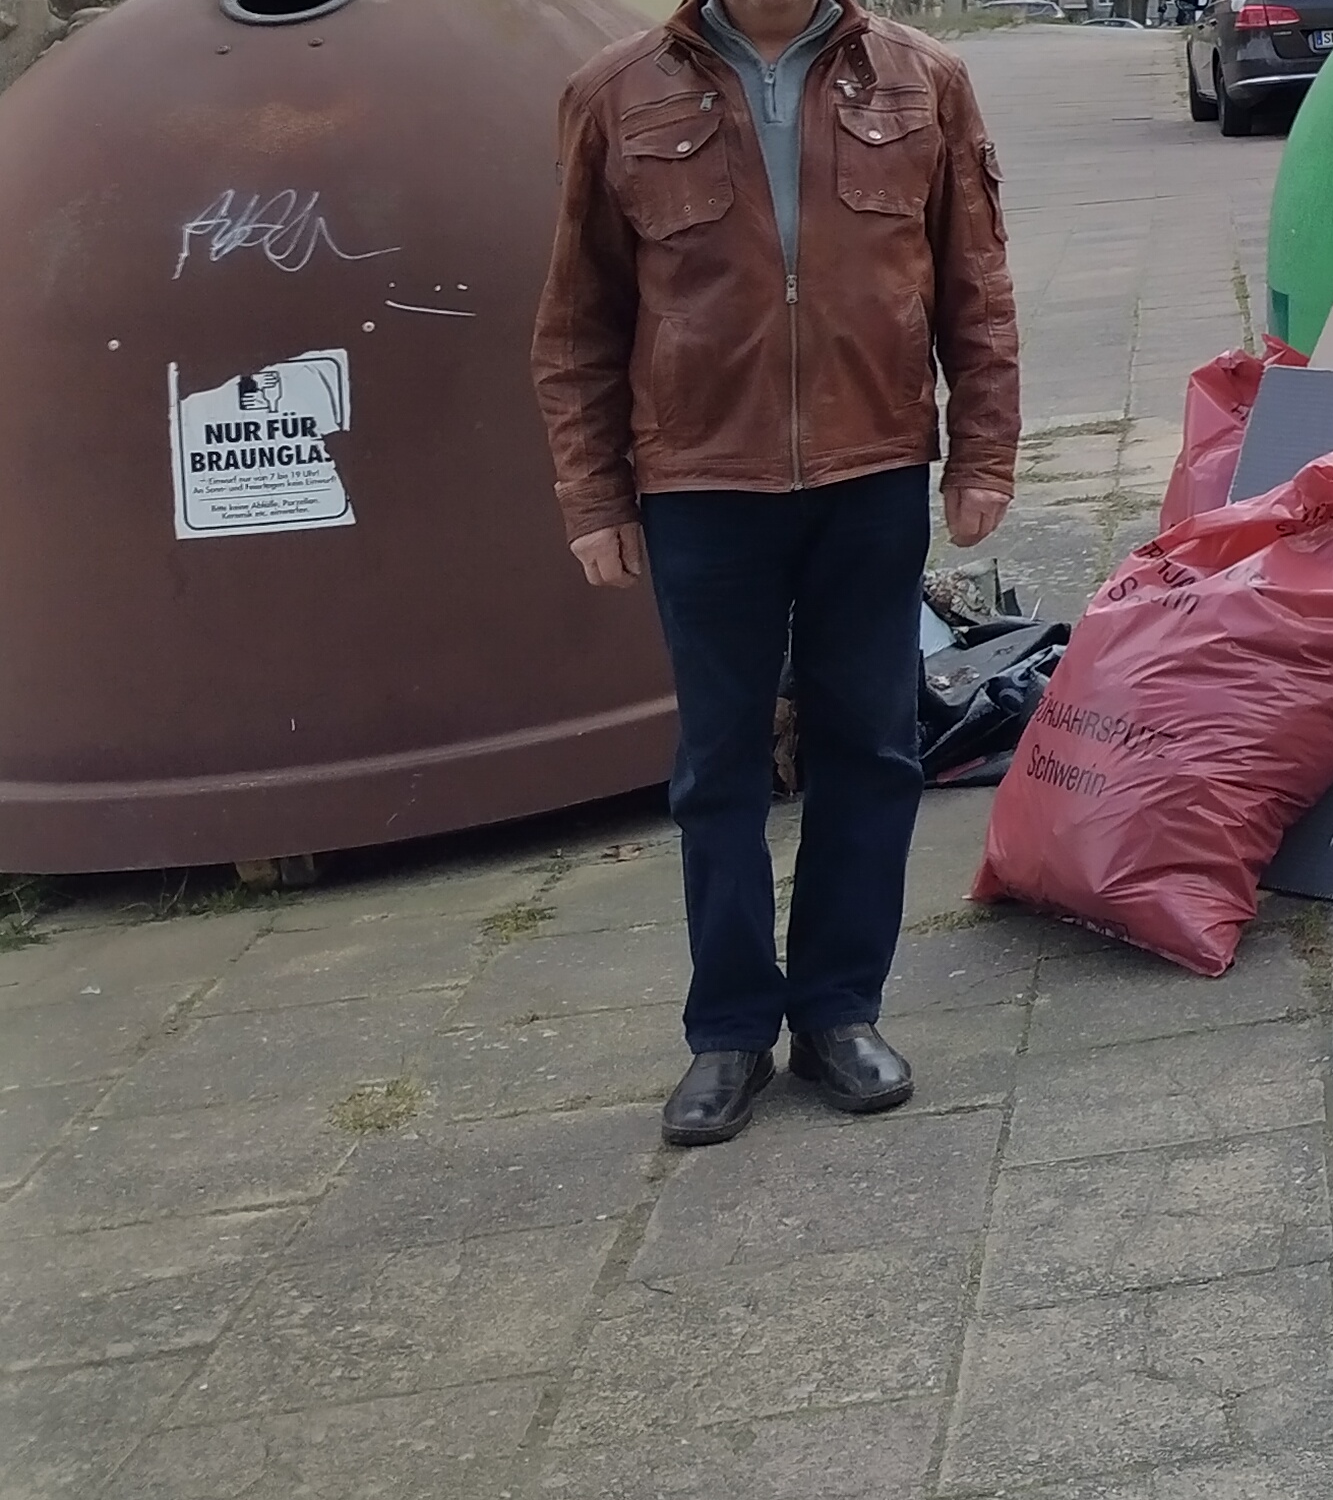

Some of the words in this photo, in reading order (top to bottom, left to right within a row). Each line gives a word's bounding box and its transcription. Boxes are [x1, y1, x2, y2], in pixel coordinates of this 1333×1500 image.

[204, 420, 262, 444] NUR
[266, 412, 317, 440] FÜR
[1027, 744, 1107, 798] Schwerin
